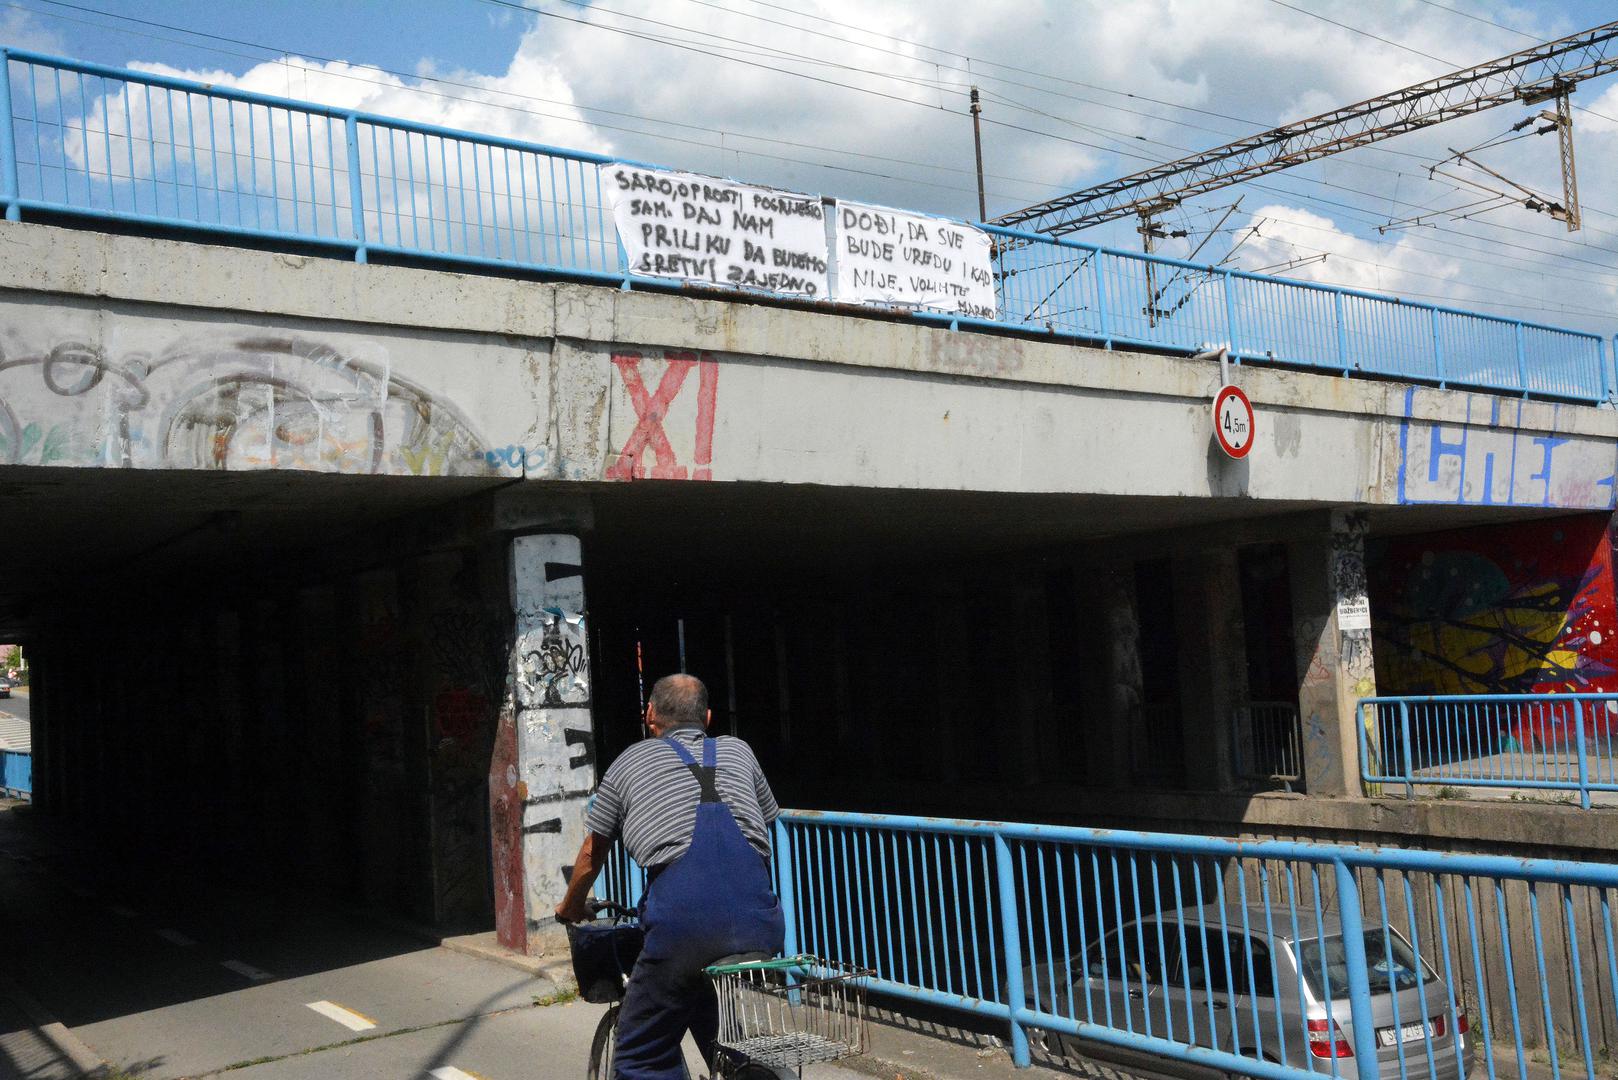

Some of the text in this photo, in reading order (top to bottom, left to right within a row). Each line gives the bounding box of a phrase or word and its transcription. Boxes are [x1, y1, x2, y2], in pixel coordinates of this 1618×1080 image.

[682, 202, 721, 226] DAJ
[733, 210, 773, 239] NAM
[907, 221, 928, 242] DA
[938, 227, 964, 249] SVE
[641, 223, 827, 274] PRILIKU DA BUDEMO
[847, 235, 895, 262] BUDE
[962, 261, 967, 279] I
[971, 266, 991, 288] KAD
[639, 252, 817, 297] SRETNI ZAJEDNO
[957, 300, 995, 320] MARKO
[1224, 410, 1246, 434] 4,5m
